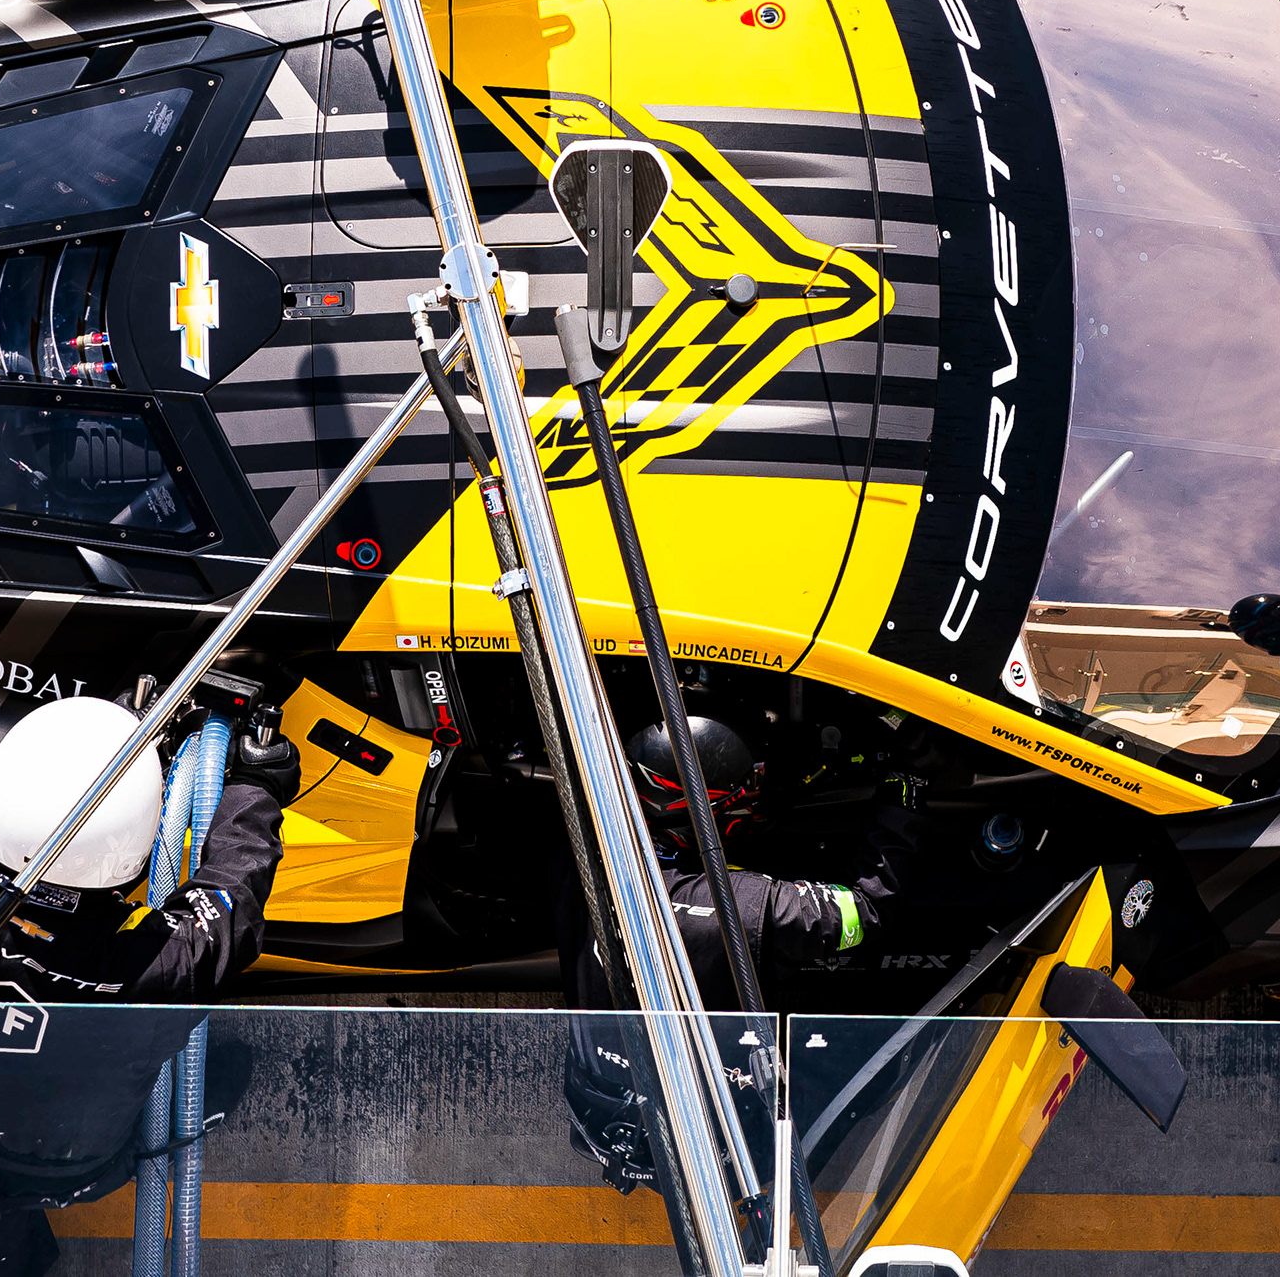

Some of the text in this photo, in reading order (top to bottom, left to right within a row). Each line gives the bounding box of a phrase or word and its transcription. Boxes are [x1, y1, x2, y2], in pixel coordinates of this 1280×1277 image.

[420, 635, 783, 669] H. KOIZUMI UD JUNCADELLA
[424, 669, 447, 704] OPEN
[991, 724, 1143, 794] www.TFSPORT.co.uk
[880, 954, 951, 969] HRX
